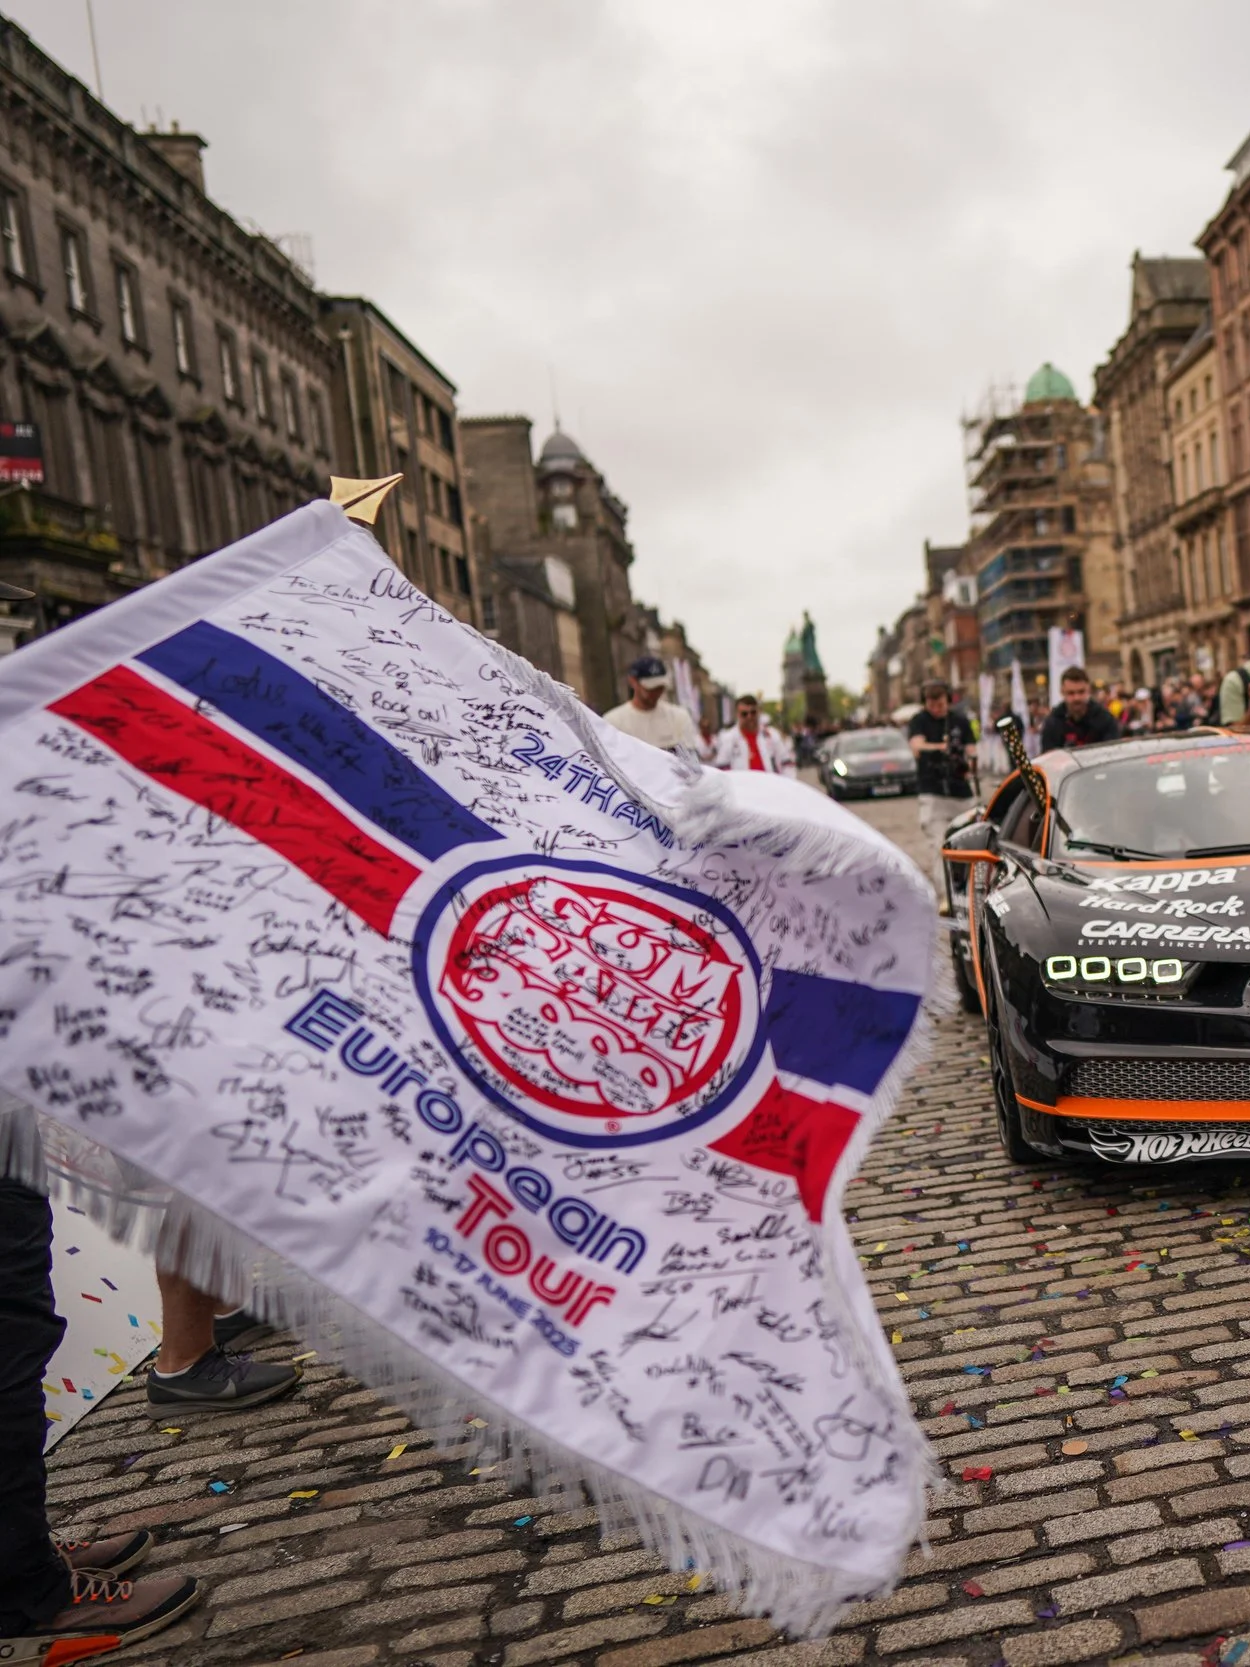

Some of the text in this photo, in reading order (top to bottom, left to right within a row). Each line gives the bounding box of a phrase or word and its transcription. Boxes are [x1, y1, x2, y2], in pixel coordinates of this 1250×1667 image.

[511, 732, 619, 813] 24TH
[1079, 895, 1245, 918] Hard Rock
[1086, 867, 1237, 894] Kappa
[528, 876, 744, 1020] GUM
[1078, 938, 1149, 948] EYEWEAR
[1159, 941, 1205, 949] SINCE
[282, 988, 648, 1276] European
[1123, 1135, 1180, 1163] HOT
[455, 1172, 618, 1329] Tour
